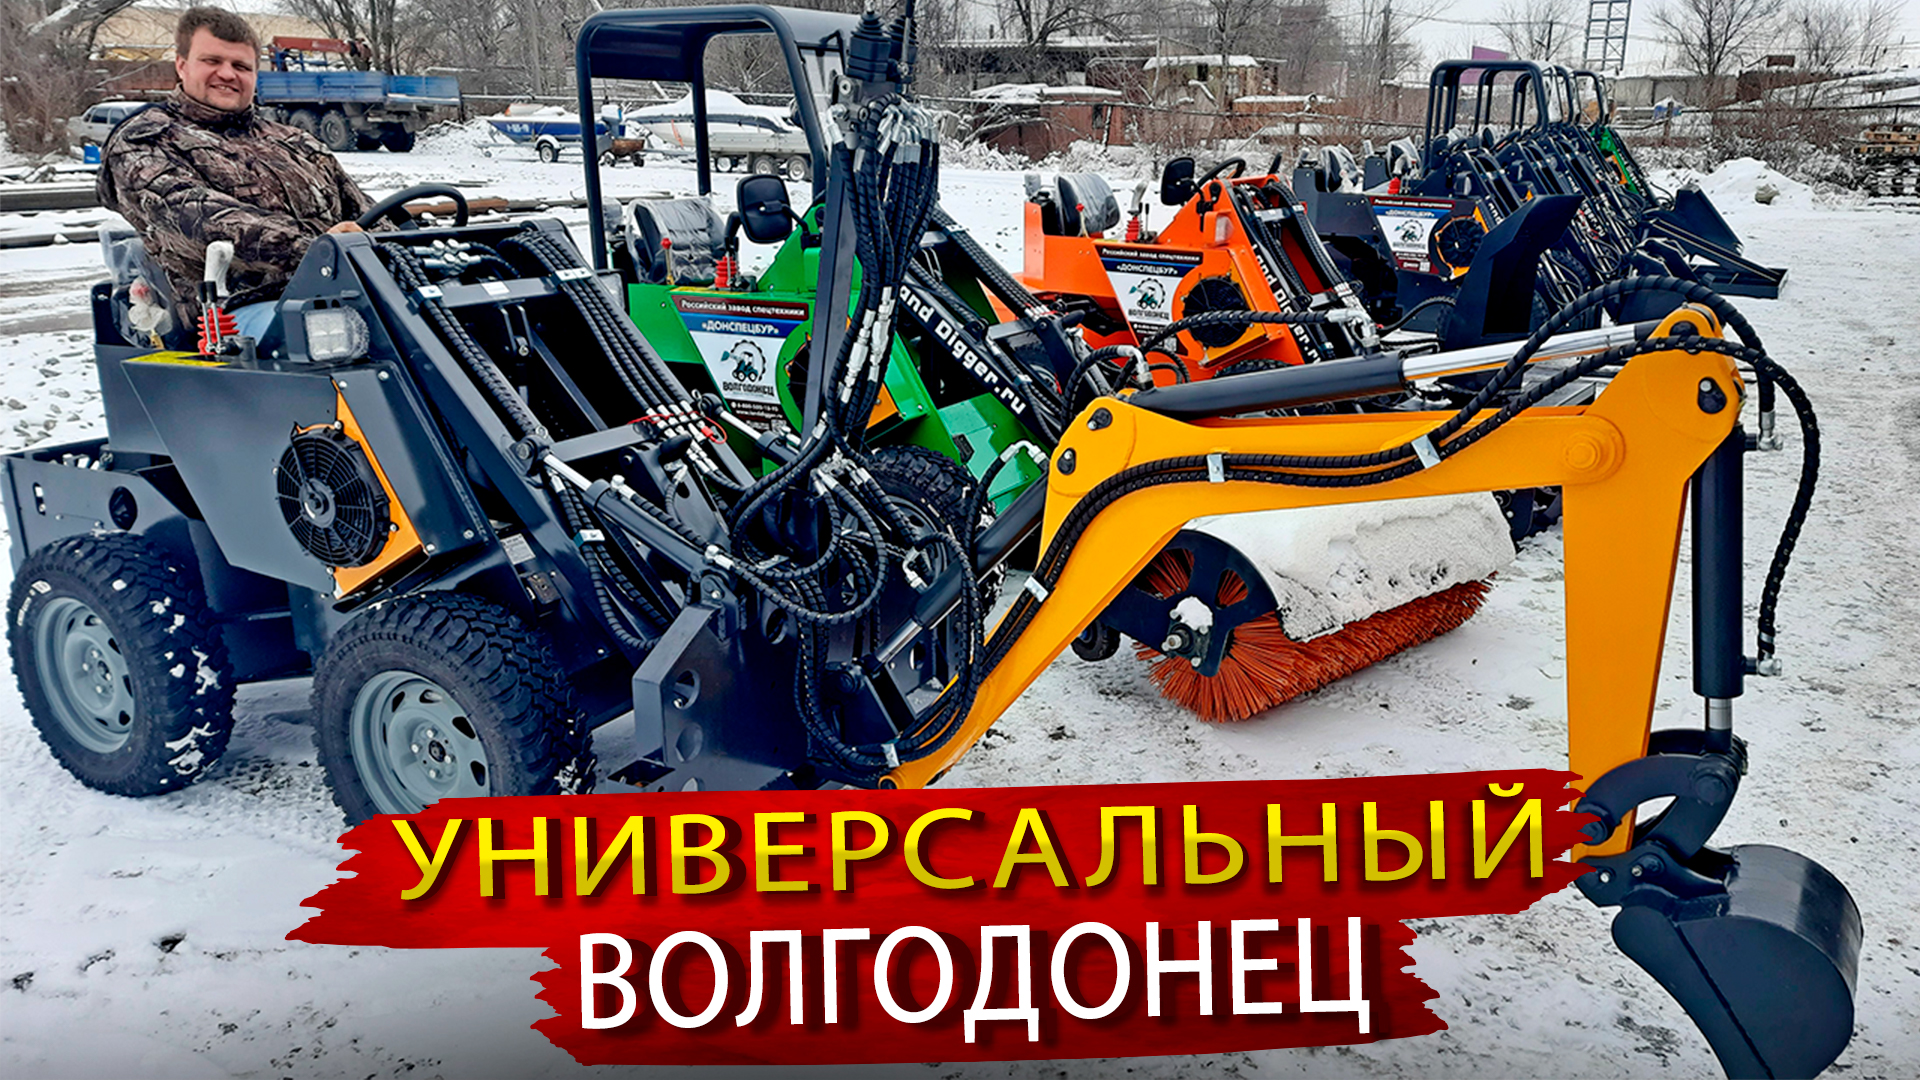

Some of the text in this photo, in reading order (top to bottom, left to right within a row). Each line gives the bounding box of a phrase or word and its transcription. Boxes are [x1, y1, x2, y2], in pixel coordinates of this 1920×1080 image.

[681, 299, 805, 316] Российский завод спецтехники
[702, 320, 779, 334] «ДОНСПЕЦБУР»
[934, 319, 1027, 415] Digger.ru
[723, 382, 775, 397] ВОЛГОДОНЕЦ
